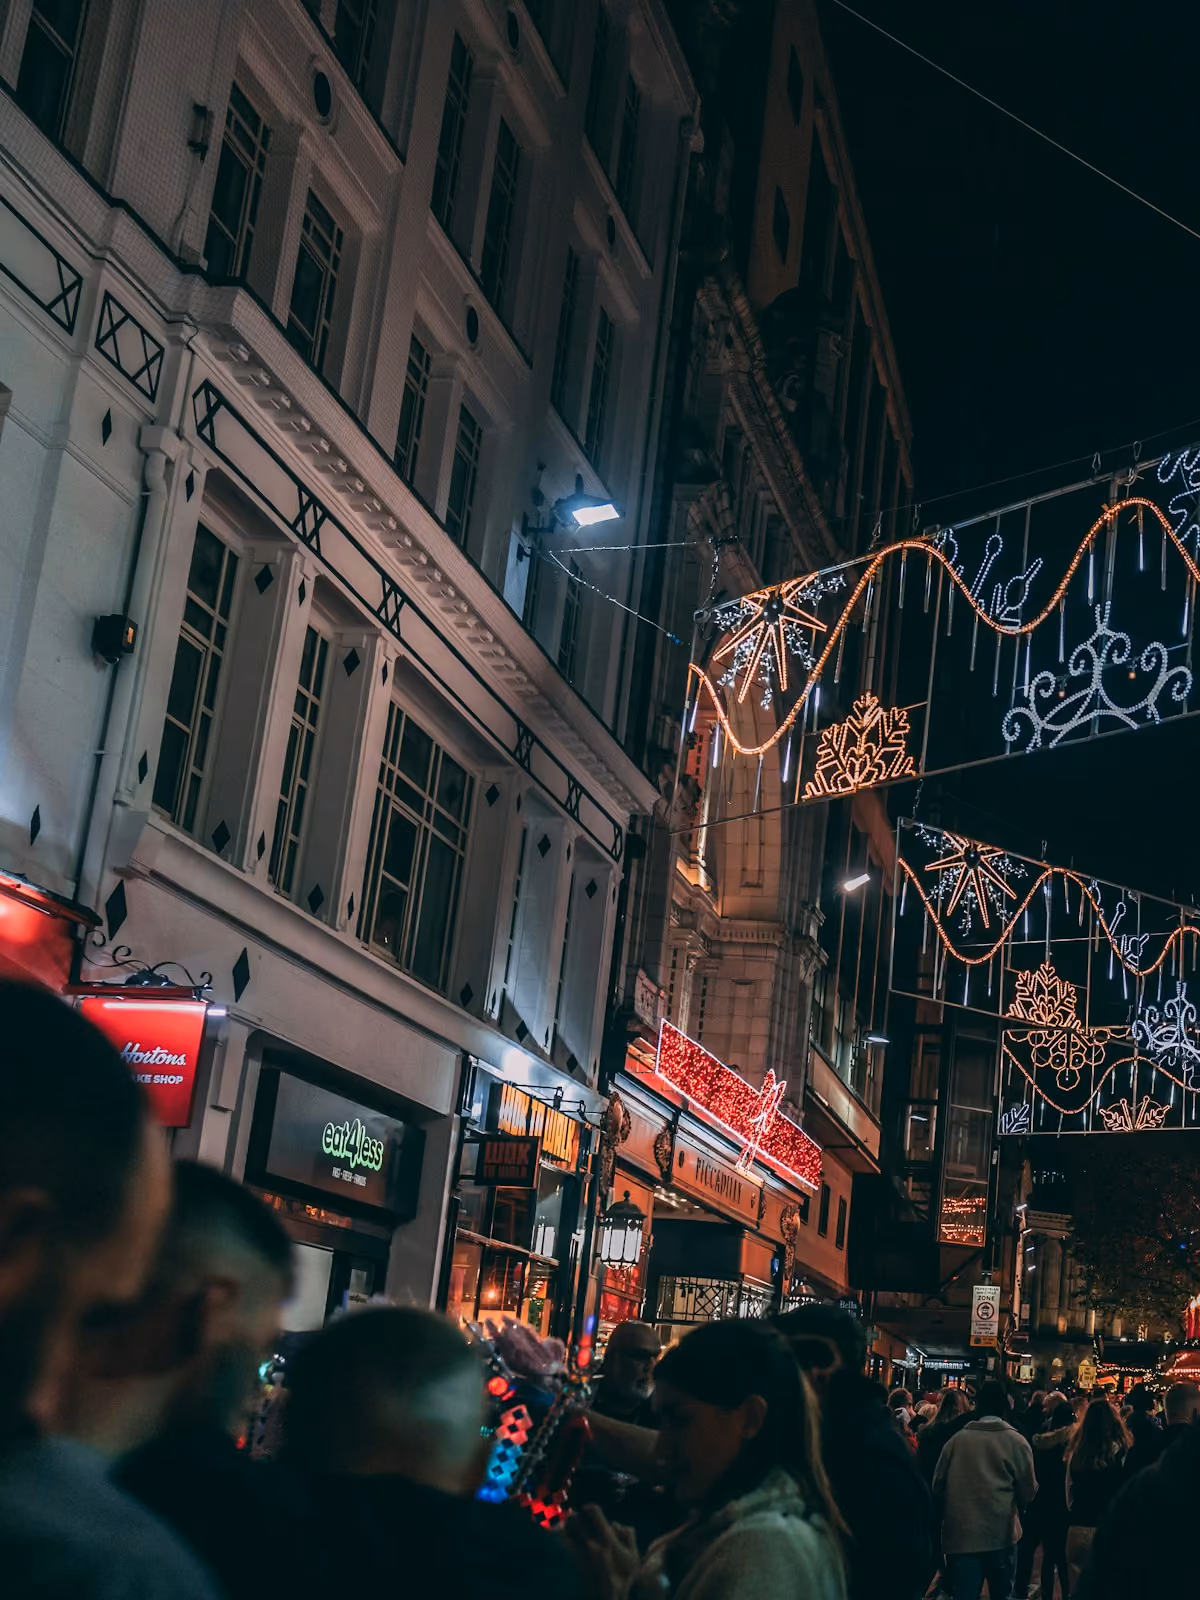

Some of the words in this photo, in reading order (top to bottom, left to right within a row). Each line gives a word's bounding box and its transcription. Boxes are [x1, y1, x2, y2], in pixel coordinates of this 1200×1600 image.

[153, 1075, 183, 1085] SHOP
[322, 1118, 384, 1171] eat4less
[695, 1157, 743, 1205] PICCADILLY
[840, 1300, 857, 1310] Bella
[924, 1360, 964, 1371] wagamama
